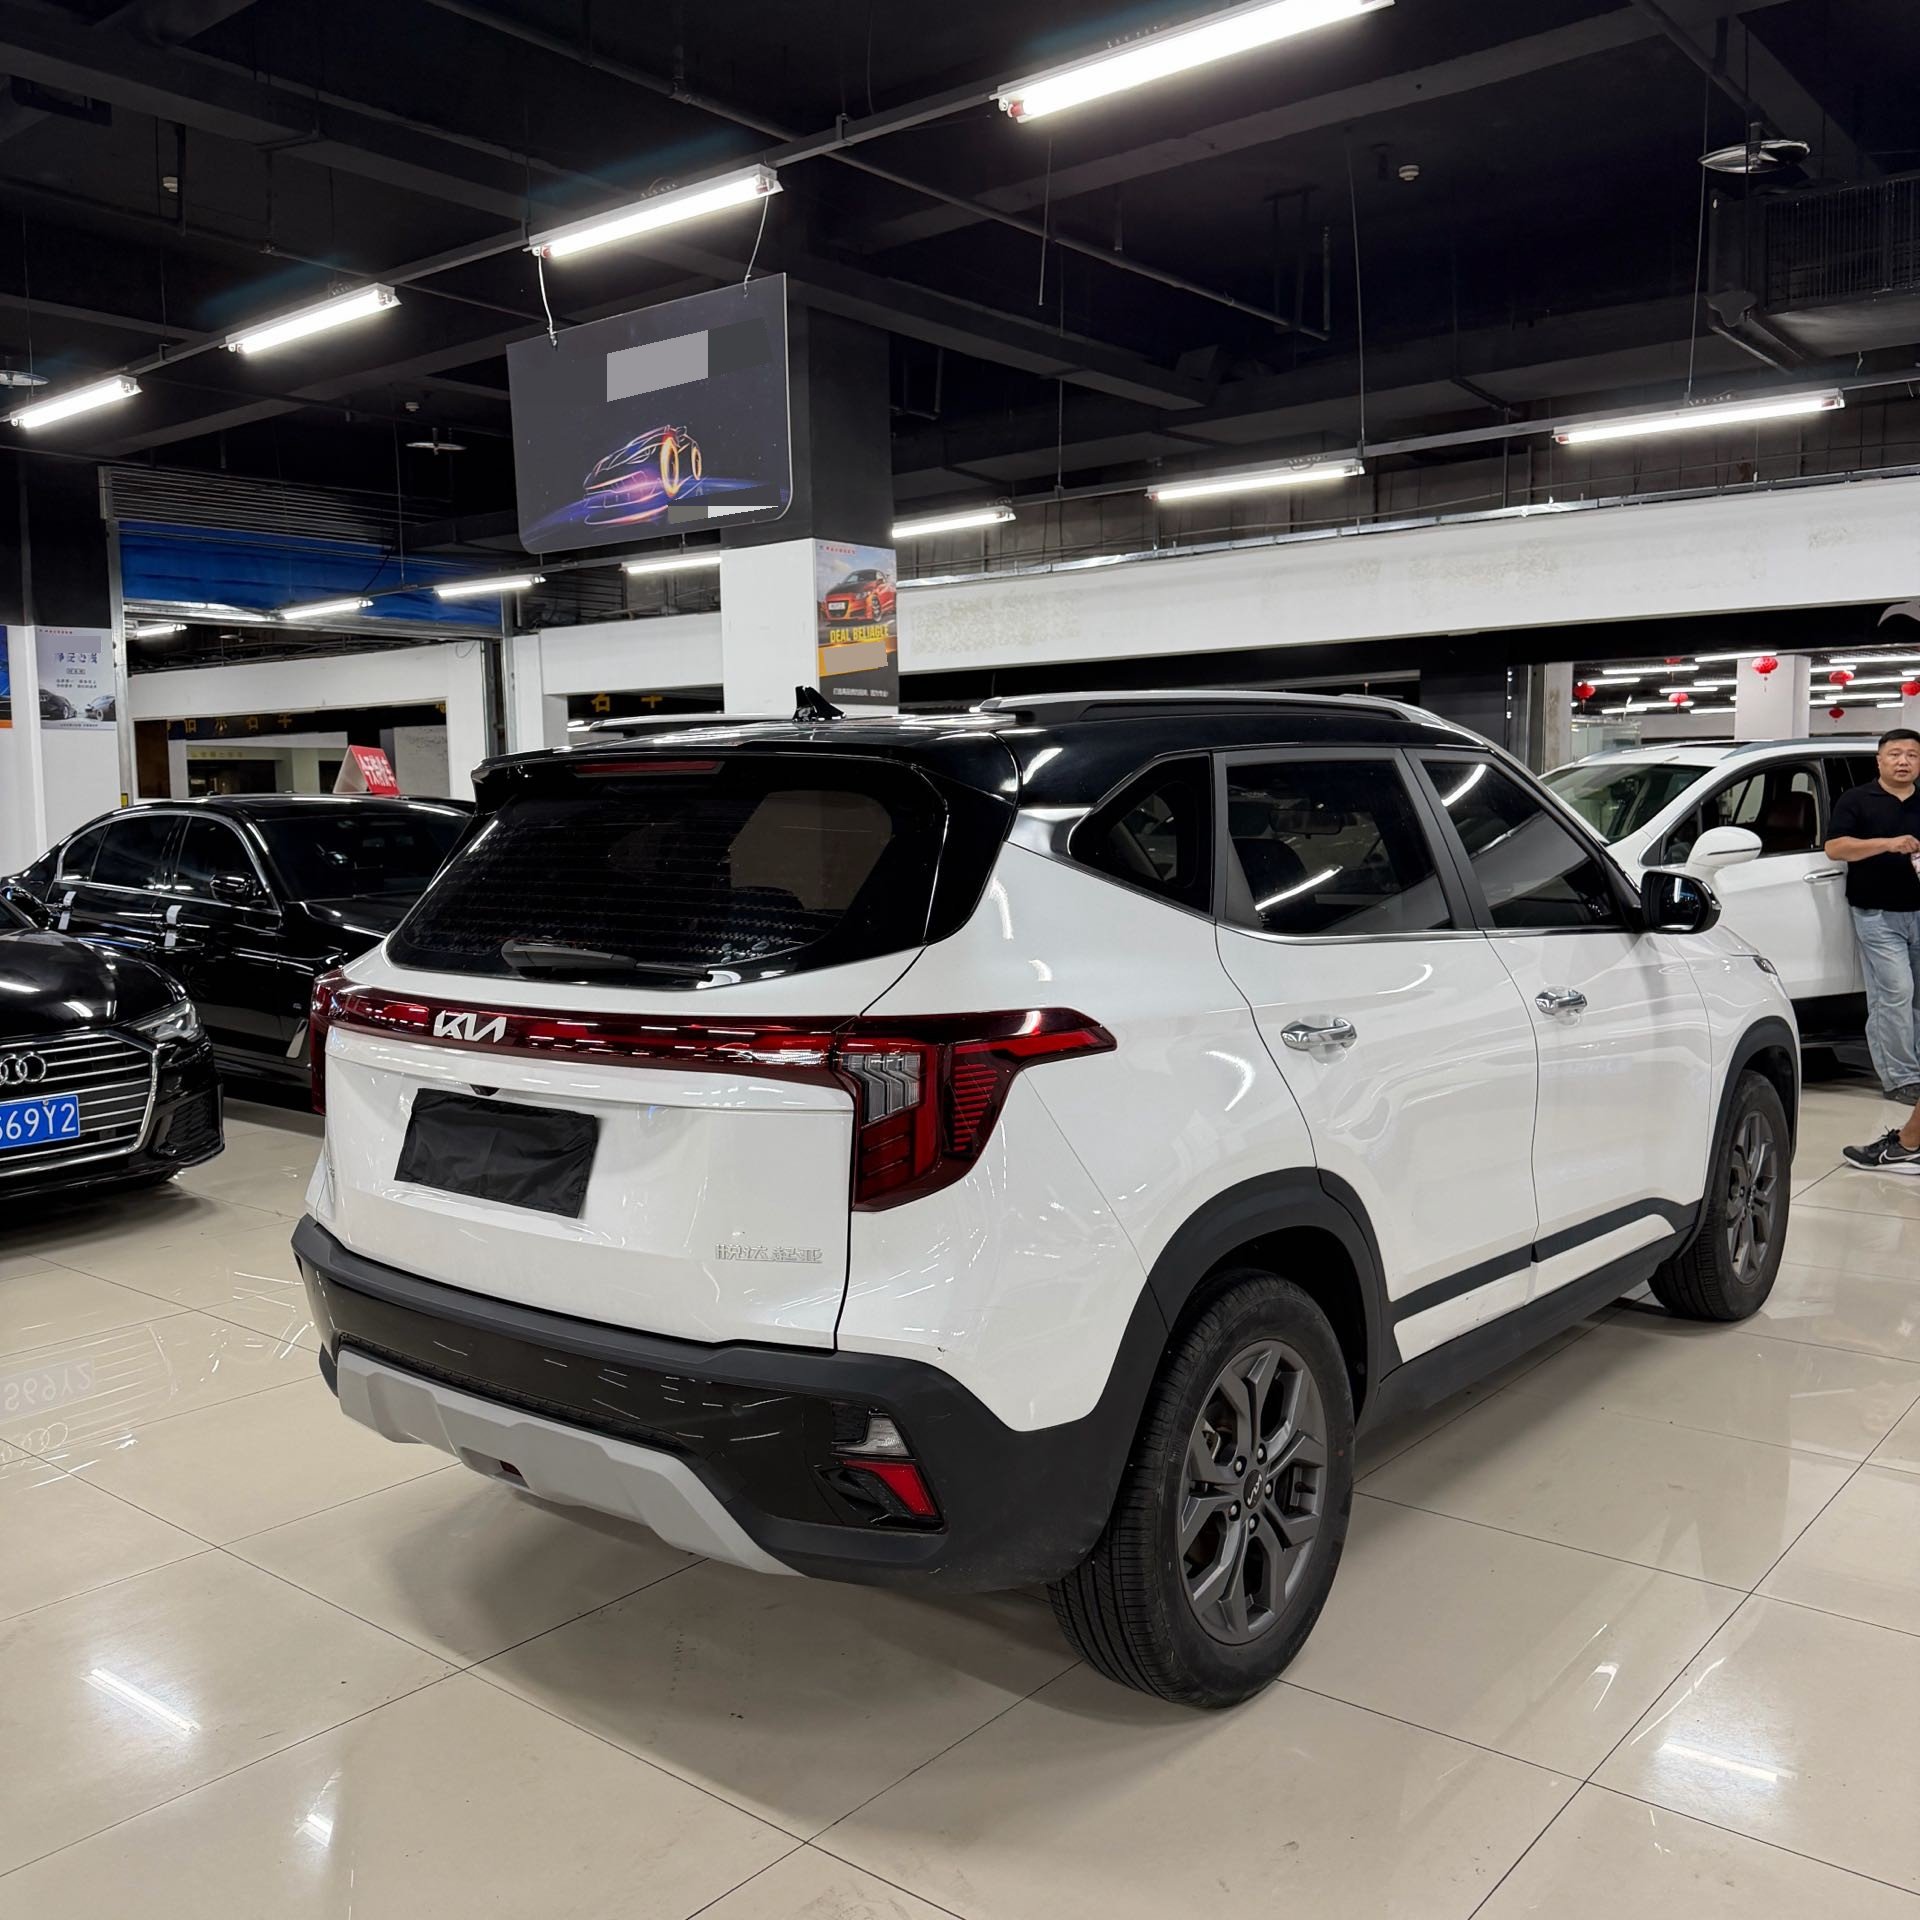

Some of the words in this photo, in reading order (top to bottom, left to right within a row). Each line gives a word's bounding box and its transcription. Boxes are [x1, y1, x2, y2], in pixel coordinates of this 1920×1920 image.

[830, 628, 849, 643] DEAL
[433, 1010, 507, 1043] KIA
[0, 1103, 77, 1139] 69Y2
